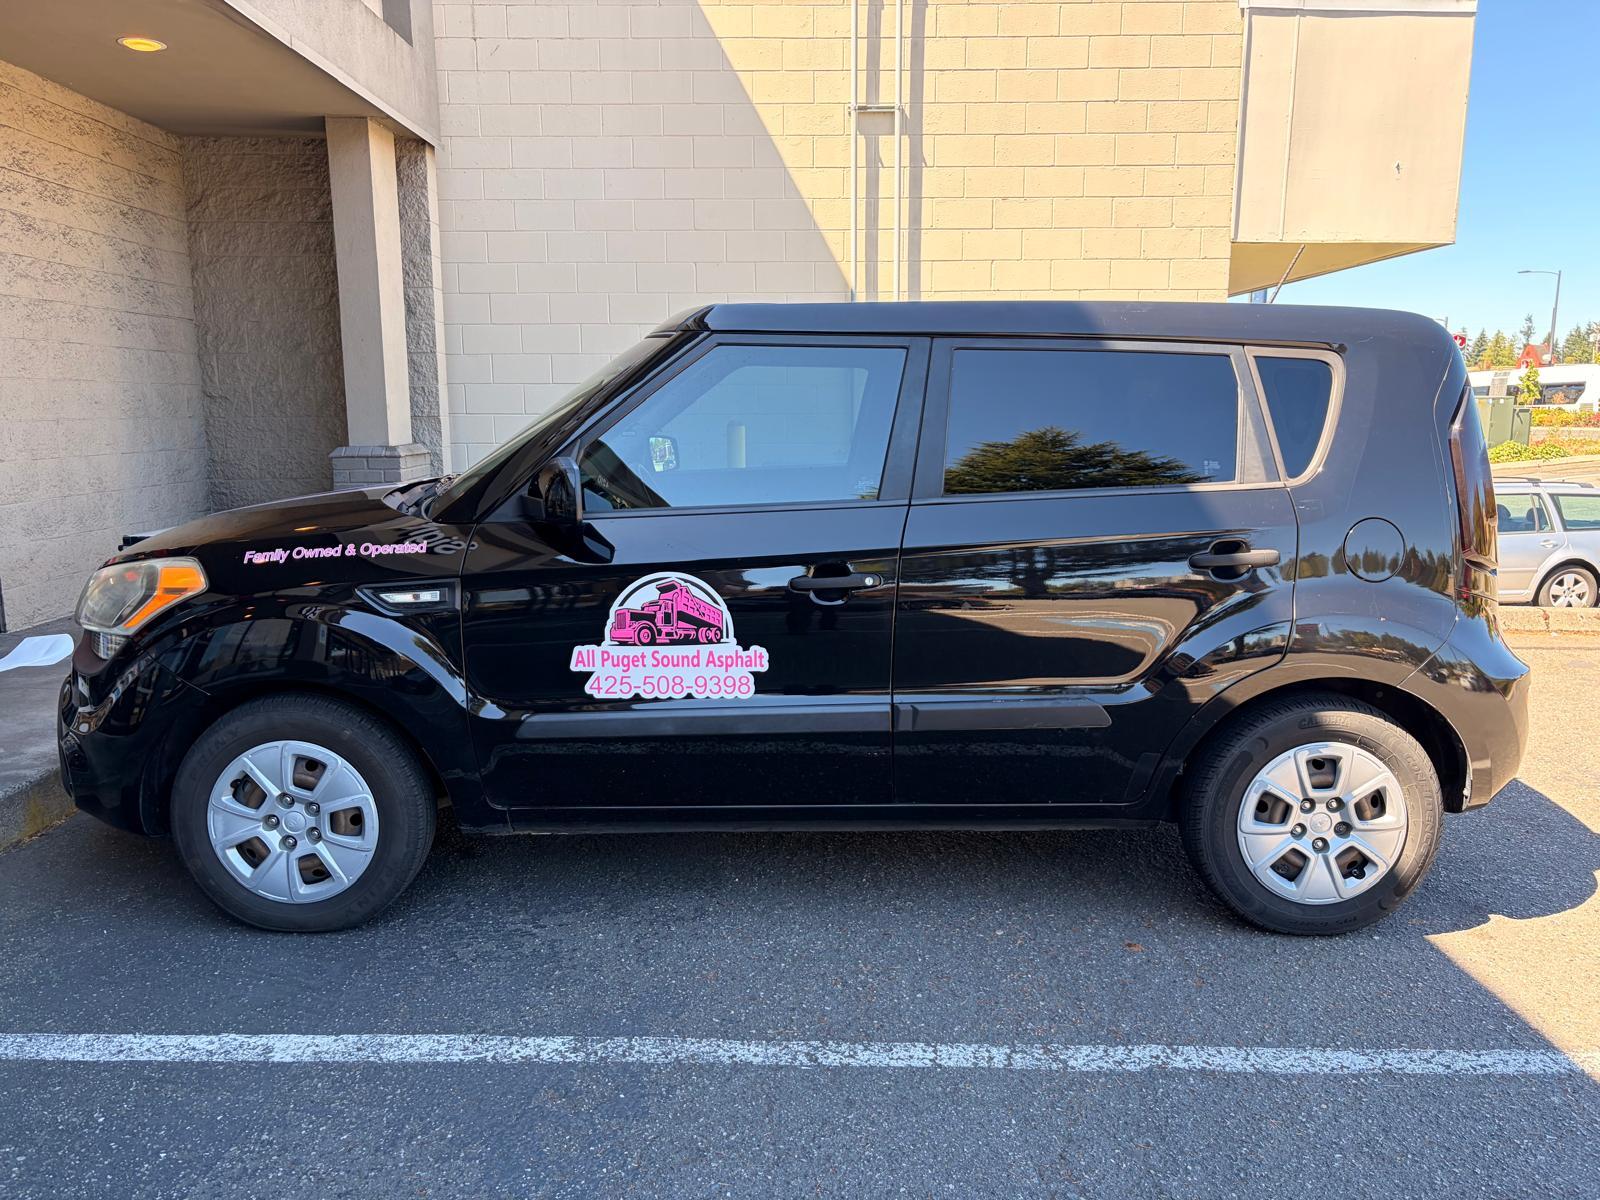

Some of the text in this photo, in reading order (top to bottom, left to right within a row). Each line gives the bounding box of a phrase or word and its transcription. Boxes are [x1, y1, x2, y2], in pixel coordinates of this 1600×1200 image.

[243, 540, 427, 564] Family Owned & Operated
[574, 650, 765, 673] All Puget Sound Asphalt
[589, 675, 751, 695] 425-508-9398
